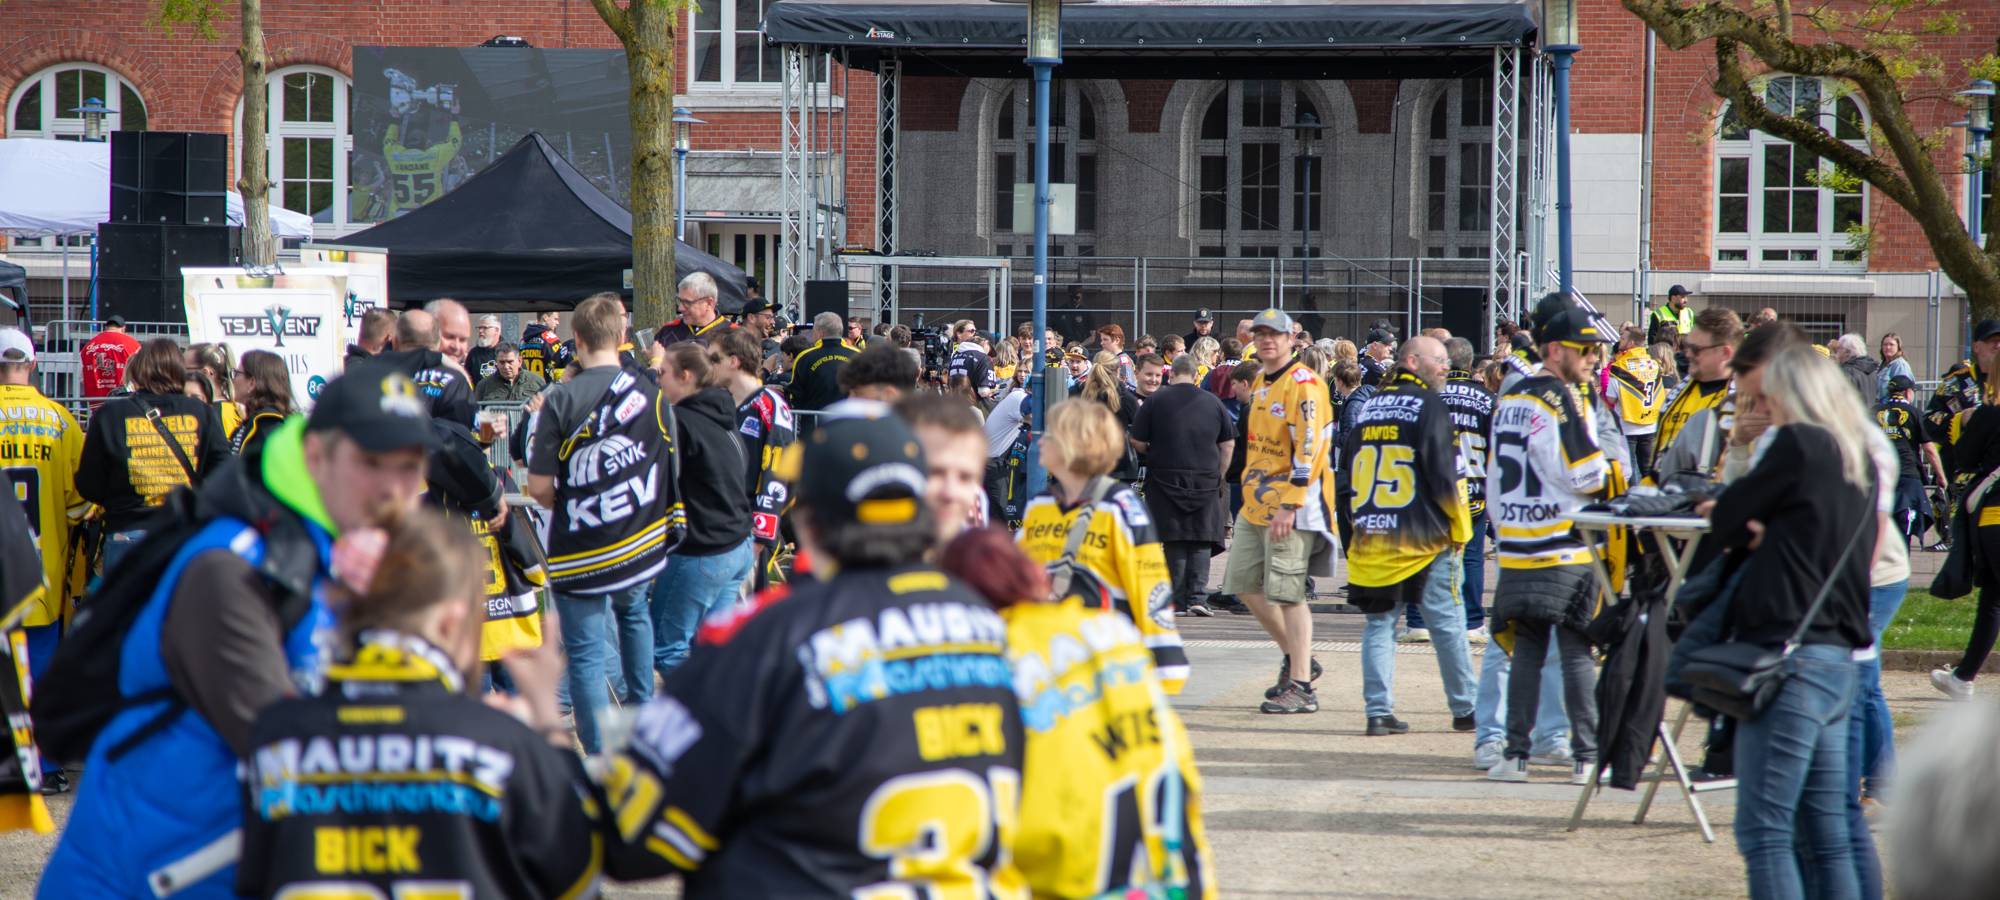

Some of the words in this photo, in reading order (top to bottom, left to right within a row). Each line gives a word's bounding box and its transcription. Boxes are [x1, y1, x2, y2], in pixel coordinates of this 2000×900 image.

[220, 316, 258, 334] TSJ
[1643, 381, 1655, 408] 3
[603, 440, 647, 476] SWK
[1350, 445, 1416, 514] 95
[566, 462, 659, 533] KEV
[1366, 514, 1397, 529] EGN
[913, 703, 1006, 762] BICK
[254, 734, 515, 793] MAURITZ
[313, 825, 422, 874] BICK
